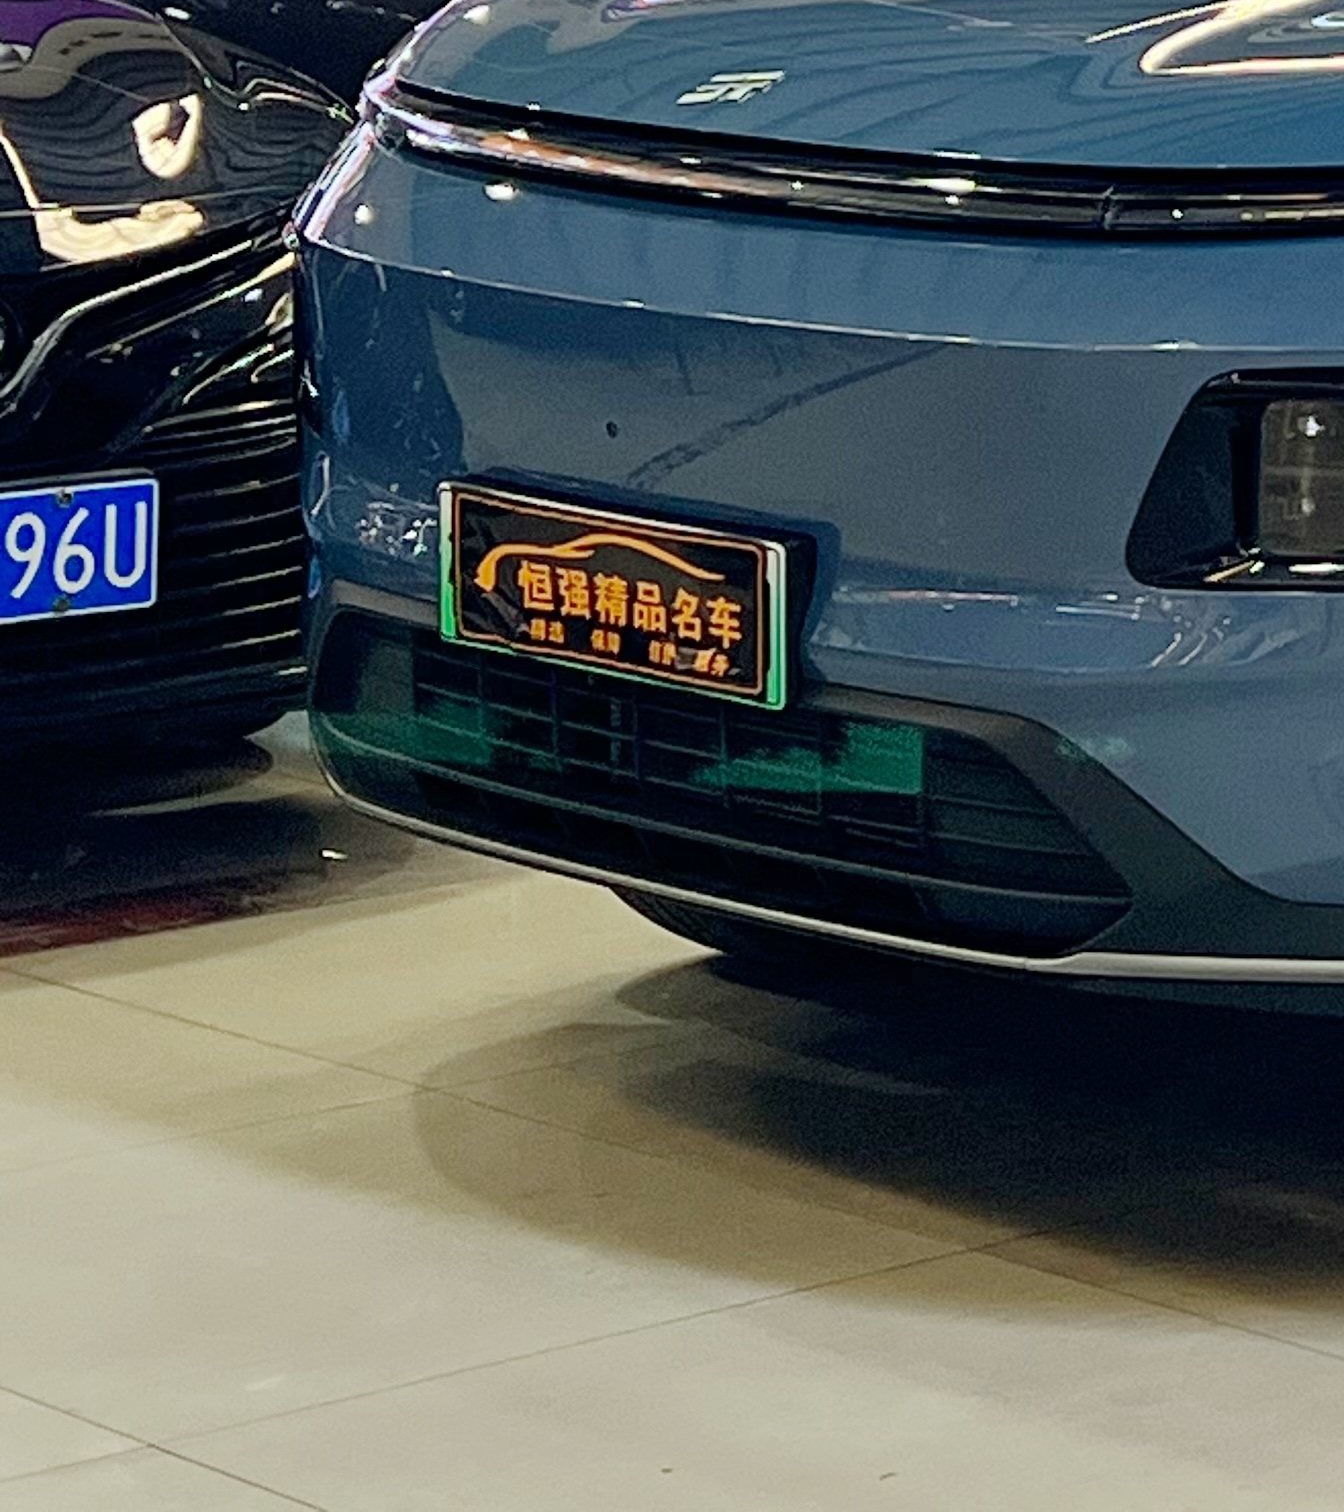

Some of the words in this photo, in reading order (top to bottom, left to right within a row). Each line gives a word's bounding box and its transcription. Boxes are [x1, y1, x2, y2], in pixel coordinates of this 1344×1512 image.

[5, 500, 149, 600] 96U
[517, 560, 743, 649] 恒强精品名车
